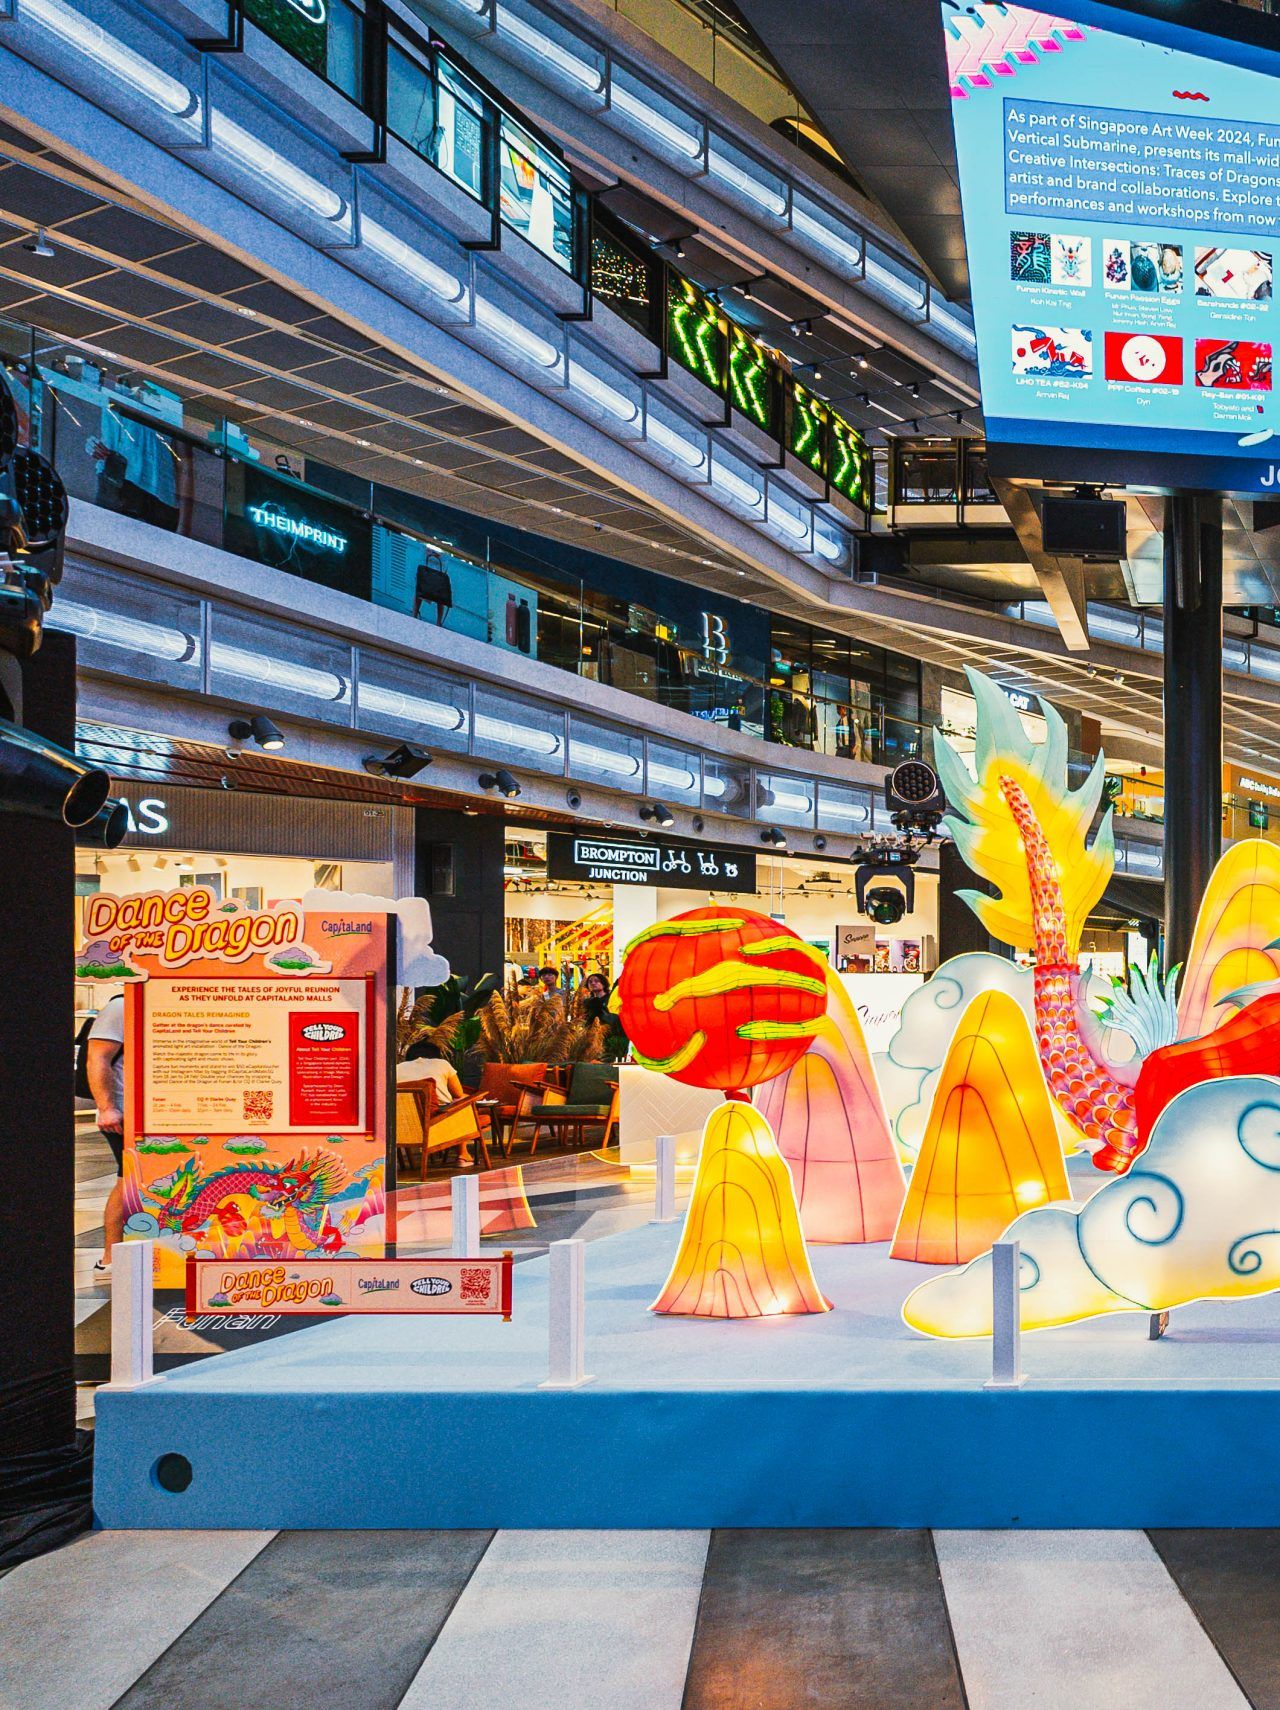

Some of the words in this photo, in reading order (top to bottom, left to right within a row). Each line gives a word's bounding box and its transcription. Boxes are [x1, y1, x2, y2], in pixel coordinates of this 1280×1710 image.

[1007, 108, 1025, 123] As
[1029, 114, 1057, 127] part
[1060, 113, 1075, 127] of
[1078, 115, 1148, 135] Singapore
[1151, 122, 1172, 137] Art
[1174, 125, 1213, 140] Week
[1216, 128, 1254, 146] 2024,
[1007, 128, 1059, 146] Vertical
[1063, 133, 1140, 155] Submarine,
[1143, 145, 1201, 159] presents
[1204, 147, 1219, 161] its
[1008, 148, 1065, 167] Creative
[1069, 155, 1160, 176] Intersections:
[1162, 163, 1205, 180] Traces
[1208, 167, 1223, 181] of
[1008, 172, 1043, 185] artist
[1046, 174, 1072, 187] and
[1076, 175, 1116, 192] brand
[1120, 180, 1219, 200] collaborations.
[1222, 188, 1272, 206] Explore
[1009, 190, 1104, 210] performances
[1107, 200, 1133, 213] and
[1136, 202, 1210, 222] workshops
[1212, 206, 1244, 222] from
[1247, 214, 1276, 225] now
[1016, 284, 1040, 293] Funan
[1104, 291, 1129, 300] Funan
[1160, 295, 1180, 306] Eggs
[1036, 378, 1050, 386] TEA
[1124, 385, 1150, 393] Coffee
[1201, 389, 1233, 399] Ray-Ban
[250, 506, 348, 552] THEIMPRINT
[581, 846, 654, 864] BROMPTON
[589, 868, 647, 882] JUNCTION
[88, 890, 210, 935] Dance
[321, 919, 372, 934] CapitaLand
[109, 934, 131, 951] OF
[134, 932, 164, 948] THE
[165, 912, 298, 962] Dragon
[220, 1266, 285, 1294] Dance
[358, 1277, 399, 1290] CapitaLand
[431, 1278, 449, 1287] YOUR
[231, 1292, 244, 1302] OF
[245, 1290, 261, 1301] THE
[261, 1277, 334, 1307] Dragon
[153, 1308, 281, 1330] Funan
